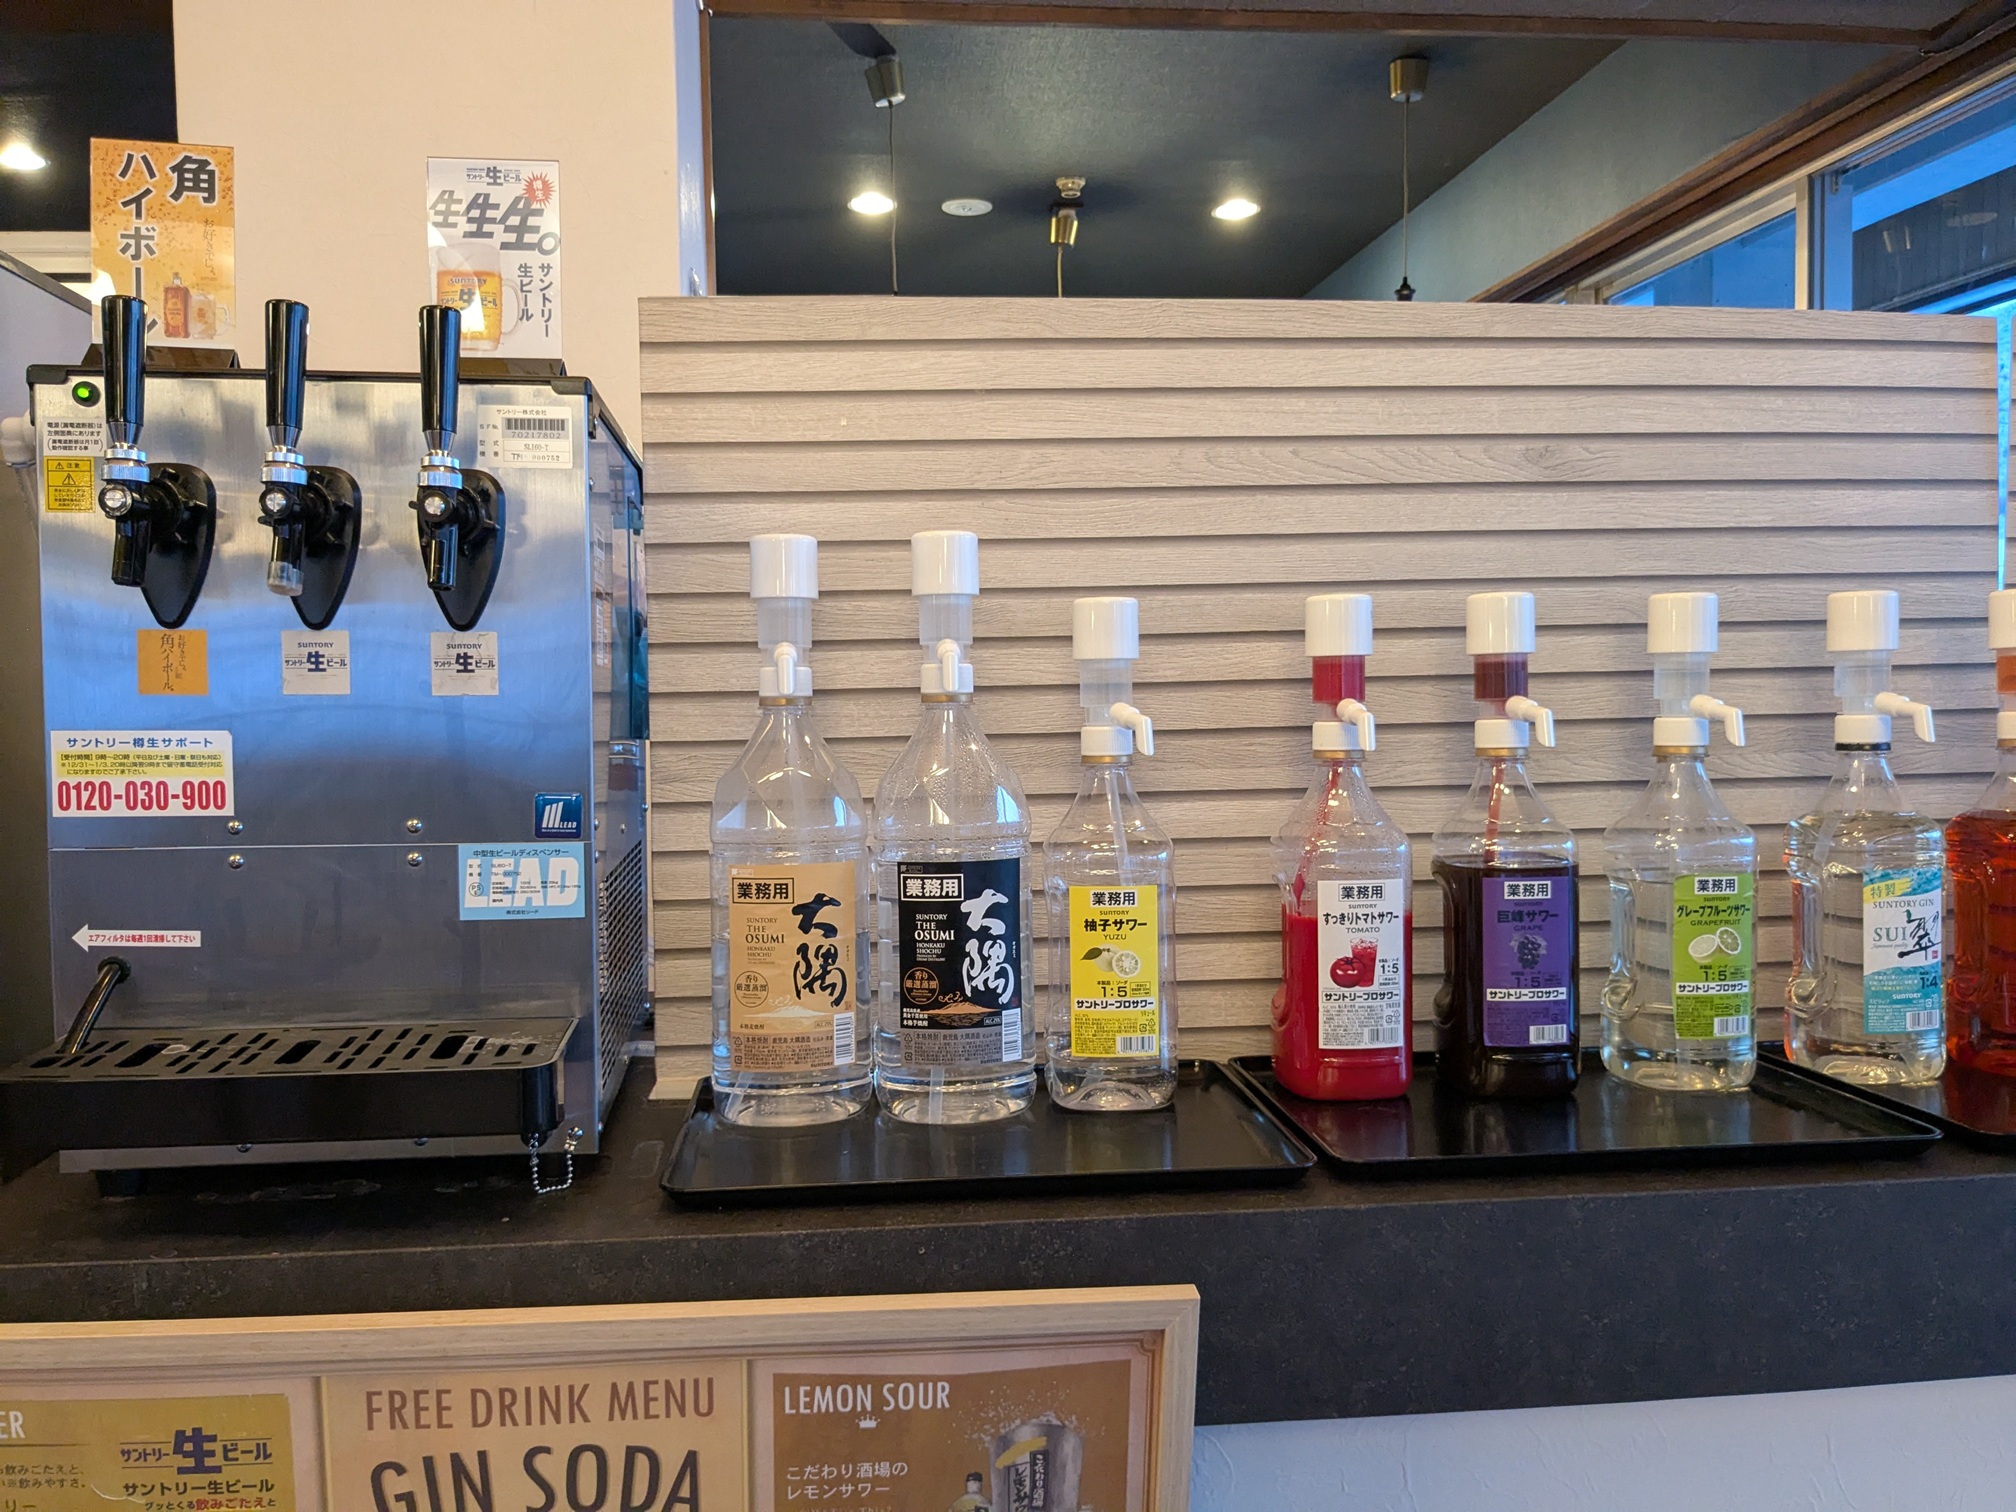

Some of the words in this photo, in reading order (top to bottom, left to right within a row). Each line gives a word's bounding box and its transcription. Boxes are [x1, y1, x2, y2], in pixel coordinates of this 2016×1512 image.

[169, 155, 217, 204] 角
[118, 153, 158, 334] ハイボー
[518, 263, 534, 322] 生ビール
[538, 263, 554, 338] サントリー
[511, 431, 562, 439] 70217802
[160, 633, 174, 692] 角ハイボール。
[284, 650, 348, 673] サントリー生ビール
[433, 651, 496, 674] サントリー生ビール
[66, 737, 213, 748] サントリー樽生サポート
[57, 780, 227, 811] 0120-030-900
[473, 849, 570, 858] 中型生ビールディスペンサー
[464, 857, 580, 908] LEAD
[905, 878, 959, 897] 業務用
[1697, 878, 1736, 893] 業務用
[736, 882, 790, 900] 業務用
[1340, 885, 1383, 900] 業務用
[1506, 883, 1549, 898] 業務用
[1870, 882, 1896, 899] 特製
[1092, 891, 1136, 906] 業務用
[1872, 899, 1918, 909] SUNTORY
[1919, 898, 1935, 907] GIN
[1322, 911, 1400, 926] すっきりトマトサワー
[1497, 909, 1559, 924] 巨峰サワー
[1676, 904, 1750, 918] グレープフルーツサワー
[746, 924, 767, 933] THE
[915, 921, 937, 930] THE
[1084, 918, 1148, 932] 柚子サワー
[1346, 926, 1381, 934] TOMATO
[1513, 924, 1544, 932] GRAPE
[1690, 918, 1742, 927] GRAPEFRUIT
[745, 933, 785, 944] OSUMI
[914, 929, 955, 941] OSUMI
[1872, 926, 1907, 942] SUI
[744, 974, 758, 983] 香り
[914, 970, 929, 980] 香り
[1489, 990, 1565, 1000] サントリープロサワー
[1678, 982, 1748, 993] サントリープロサワー
[1324, 991, 1399, 1002] サントリープロサワー
[1892, 992, 1922, 1000] SUNTORY
[1076, 999, 1154, 1010] サントリープロサワー
[365, 1388, 454, 1431] FREE
[470, 1383, 592, 1428] DRINK
[607, 1376, 715, 1422] MENU
[784, 1384, 873, 1416] LEMON
[882, 1381, 951, 1412] SOUR
[120, 1427, 273, 1475] サントリー生ビール
[370, 1449, 494, 1512] GIN
[523, 1443, 702, 1512] SODA
[787, 1461, 908, 1480] こだわり酒場の
[123, 1479, 275, 1497] サントリー生ビール
[787, 1483, 891, 1500] レモンサワー
